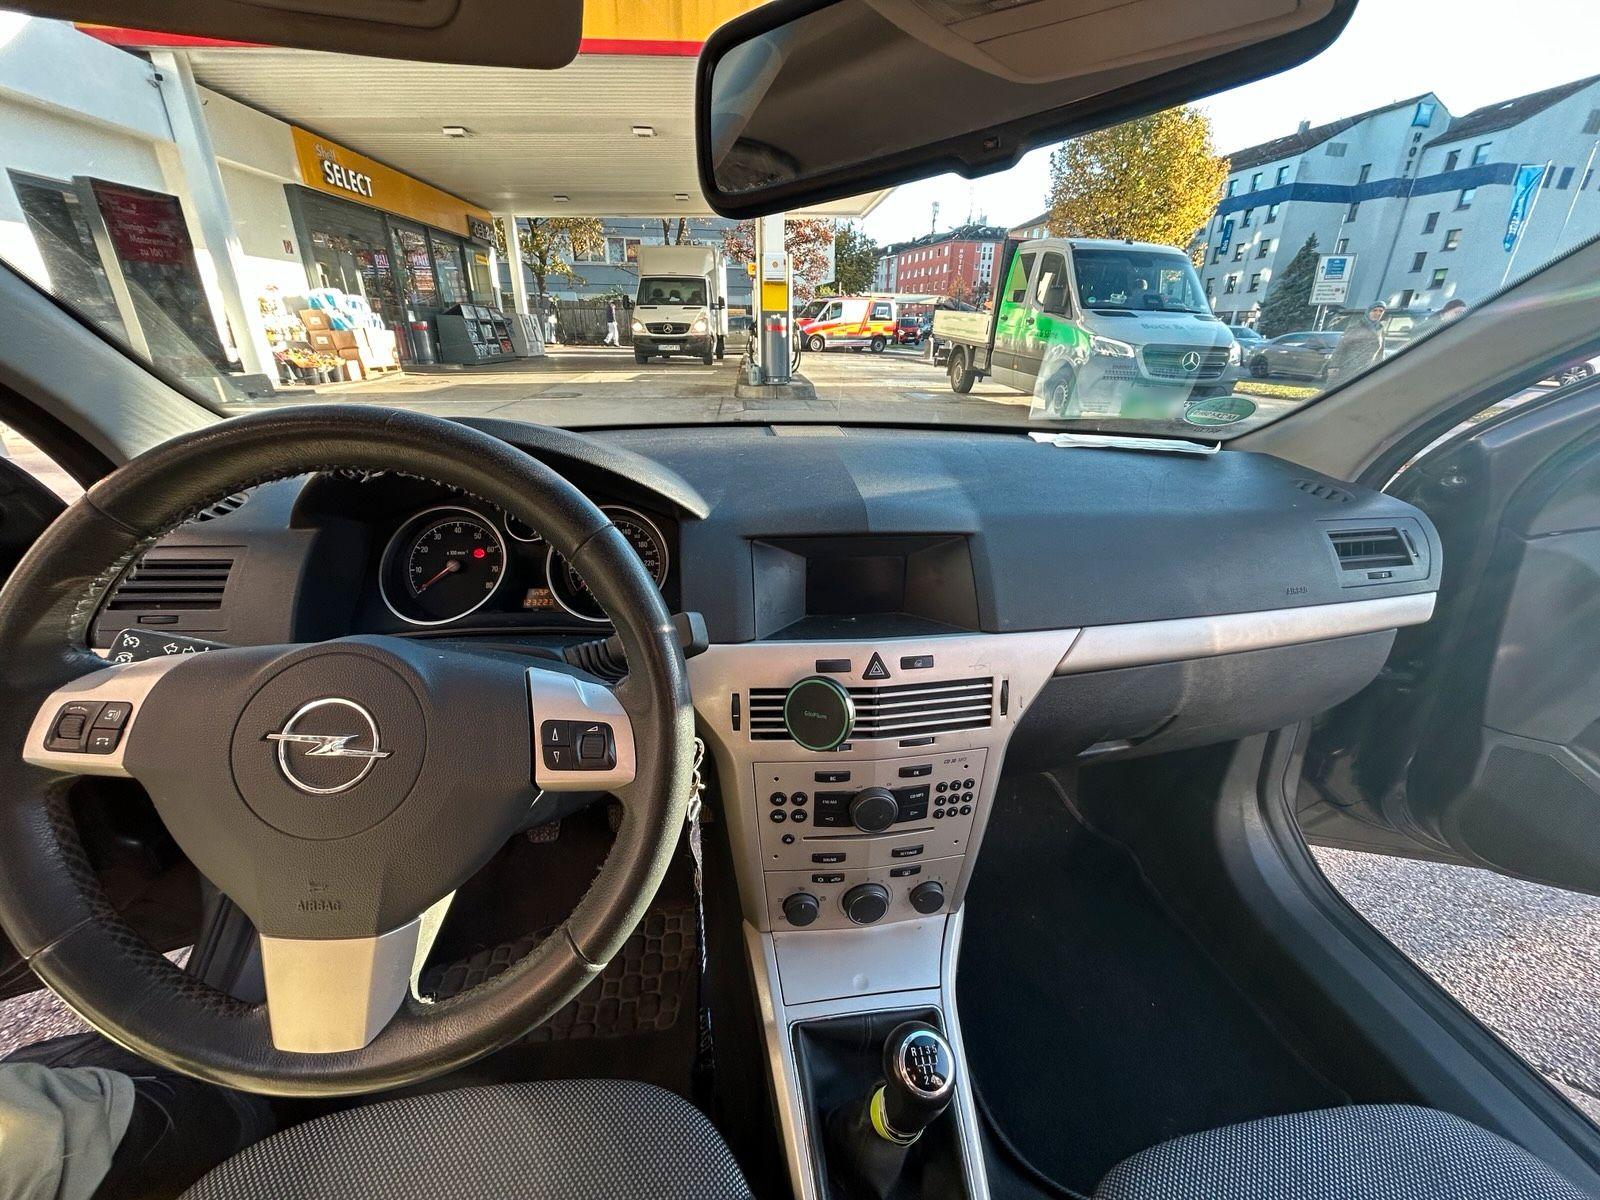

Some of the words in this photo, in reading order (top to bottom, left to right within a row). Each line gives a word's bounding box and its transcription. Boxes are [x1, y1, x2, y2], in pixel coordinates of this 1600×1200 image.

[323, 160, 373, 198] SELECT
[454, 526, 462, 534] 40
[433, 533, 442, 541] 30
[473, 532, 482, 540] 50
[415, 566, 423, 574] 10
[298, 900, 342, 911] AIRBAG
[911, 1046, 918, 1057] R
[918, 1046, 924, 1056] 1
[925, 1045, 931, 1054] 3
[931, 1044, 937, 1053] 5
[924, 1075, 930, 1085] 2
